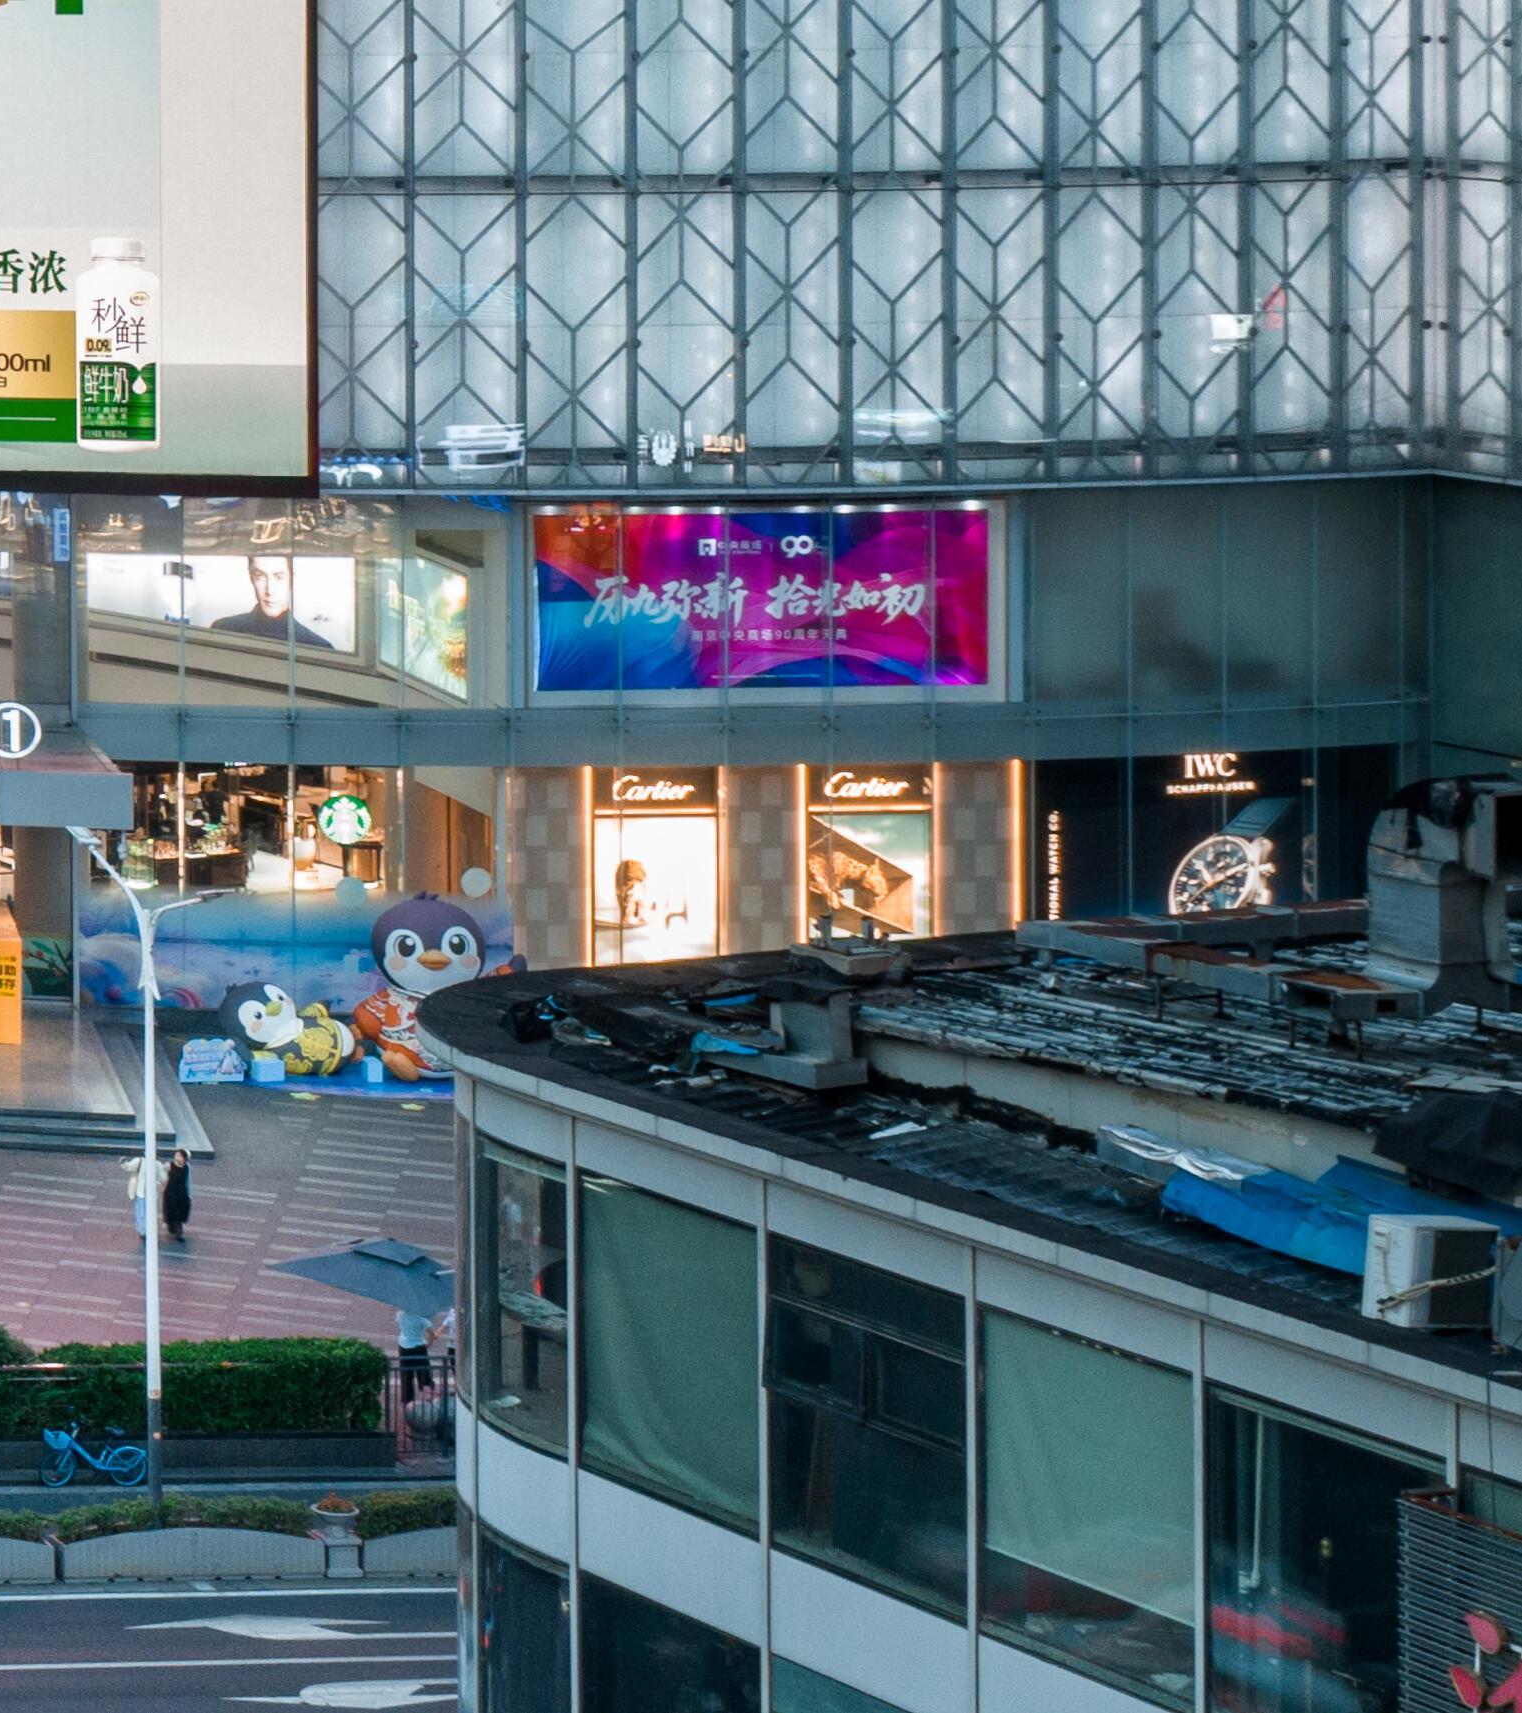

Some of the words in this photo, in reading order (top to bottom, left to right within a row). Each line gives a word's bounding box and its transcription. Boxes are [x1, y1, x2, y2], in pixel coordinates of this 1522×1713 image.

[92, 297, 147, 354] 秒鲜
[84, 365, 129, 404] 鲜牛奶
[1183, 752, 1239, 779] IWC
[611, 774, 696, 801] Cartier
[824, 771, 911, 799] Cartier
[1047, 833, 1063, 875] WATCH
